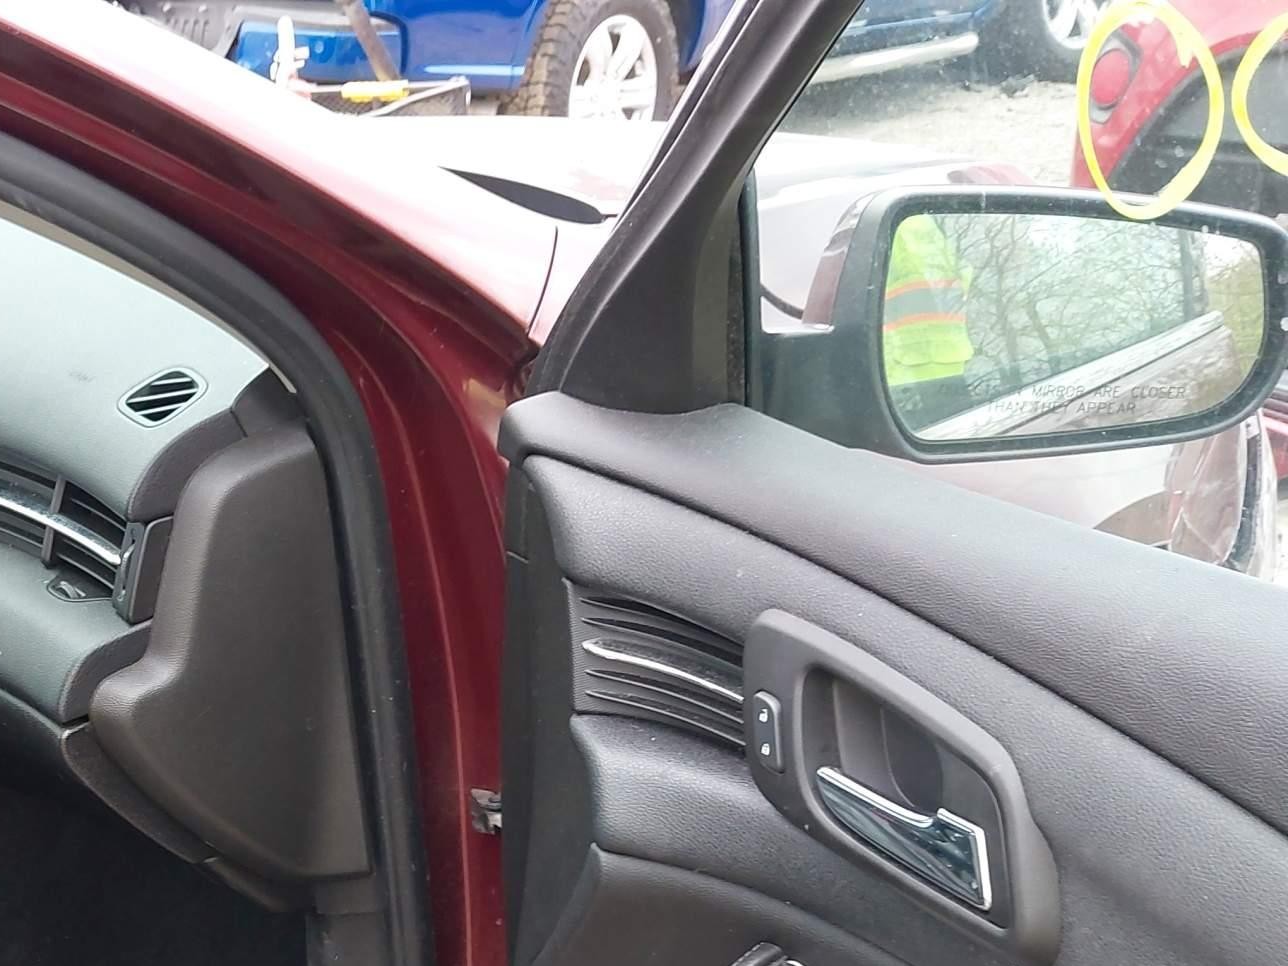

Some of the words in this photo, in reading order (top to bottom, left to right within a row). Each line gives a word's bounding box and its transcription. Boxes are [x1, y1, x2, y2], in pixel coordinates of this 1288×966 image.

[1094, 385, 1121, 399] ARE
[1132, 386, 1186, 400] CLOSER
[1076, 401, 1136, 415] APPEAR
